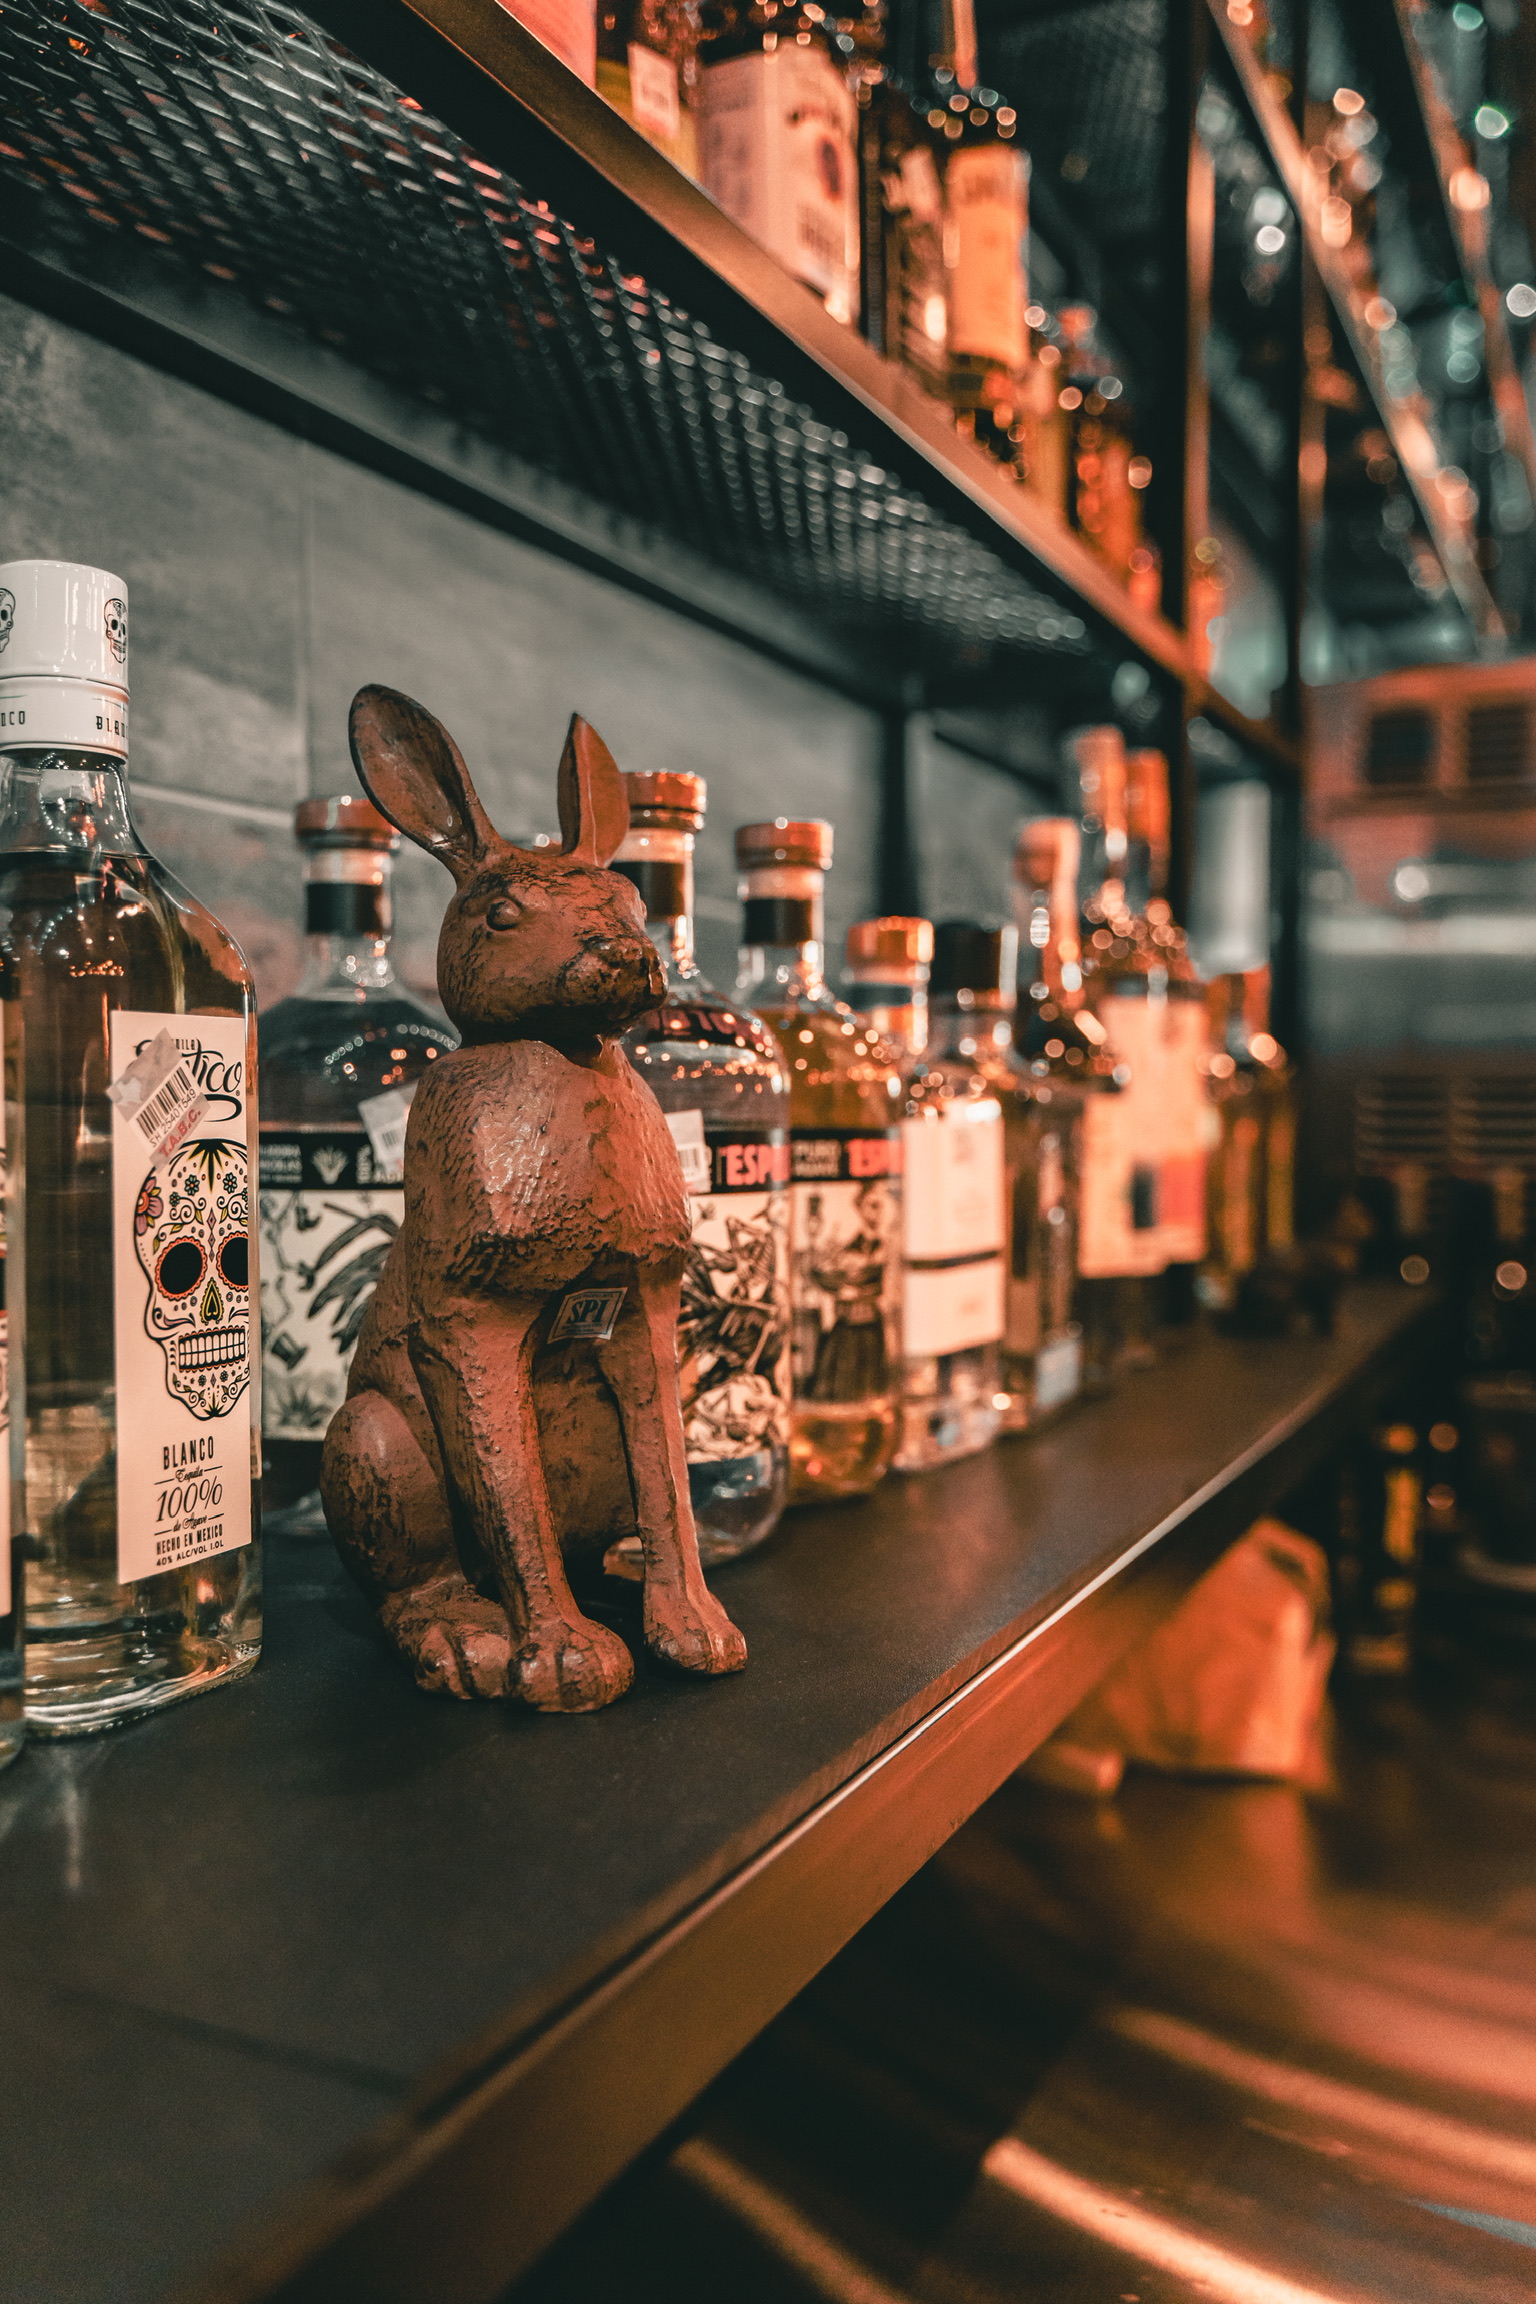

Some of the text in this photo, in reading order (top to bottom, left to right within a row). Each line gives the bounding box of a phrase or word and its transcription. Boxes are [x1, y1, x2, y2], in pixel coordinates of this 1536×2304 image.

[159, 1108, 201, 1157] T.A.B.C.
[163, 1435, 214, 1470] BLANCO
[155, 1475, 223, 1523] 100%
[156, 1523, 223, 1555] HECHO EN MEXICO
[156, 1555, 173, 1566] 40%
[176, 1544, 208, 1562] ALC/VOL
